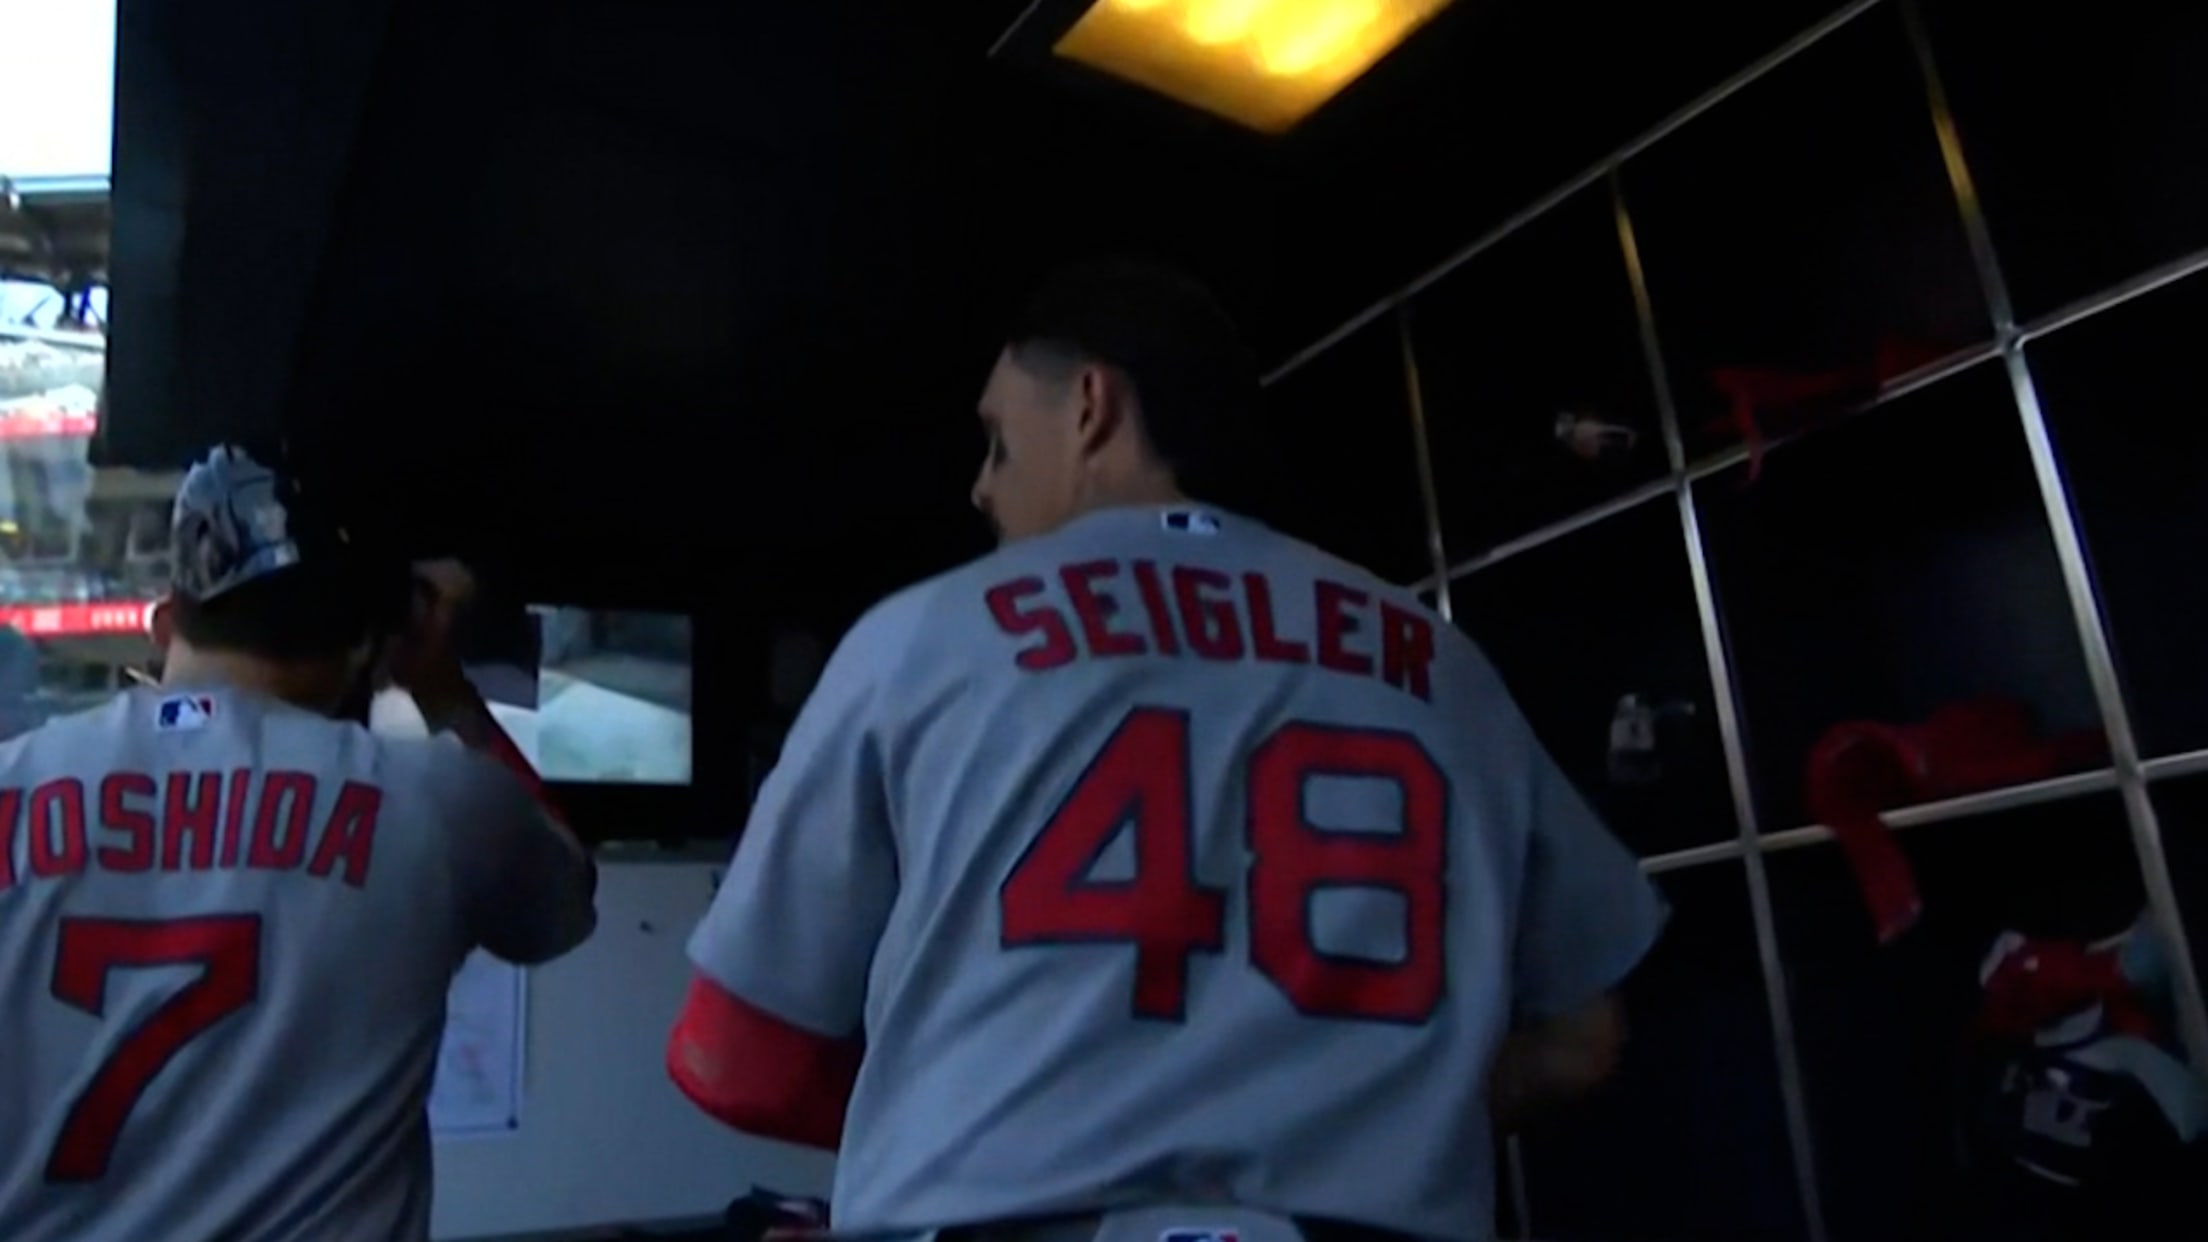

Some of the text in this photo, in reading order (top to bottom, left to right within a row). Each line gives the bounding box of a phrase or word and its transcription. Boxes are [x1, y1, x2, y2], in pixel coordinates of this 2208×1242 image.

[984, 558, 1437, 702] SEIGLER
[1000, 707, 1449, 1025] 48
[44, 911, 262, 1185] 7
